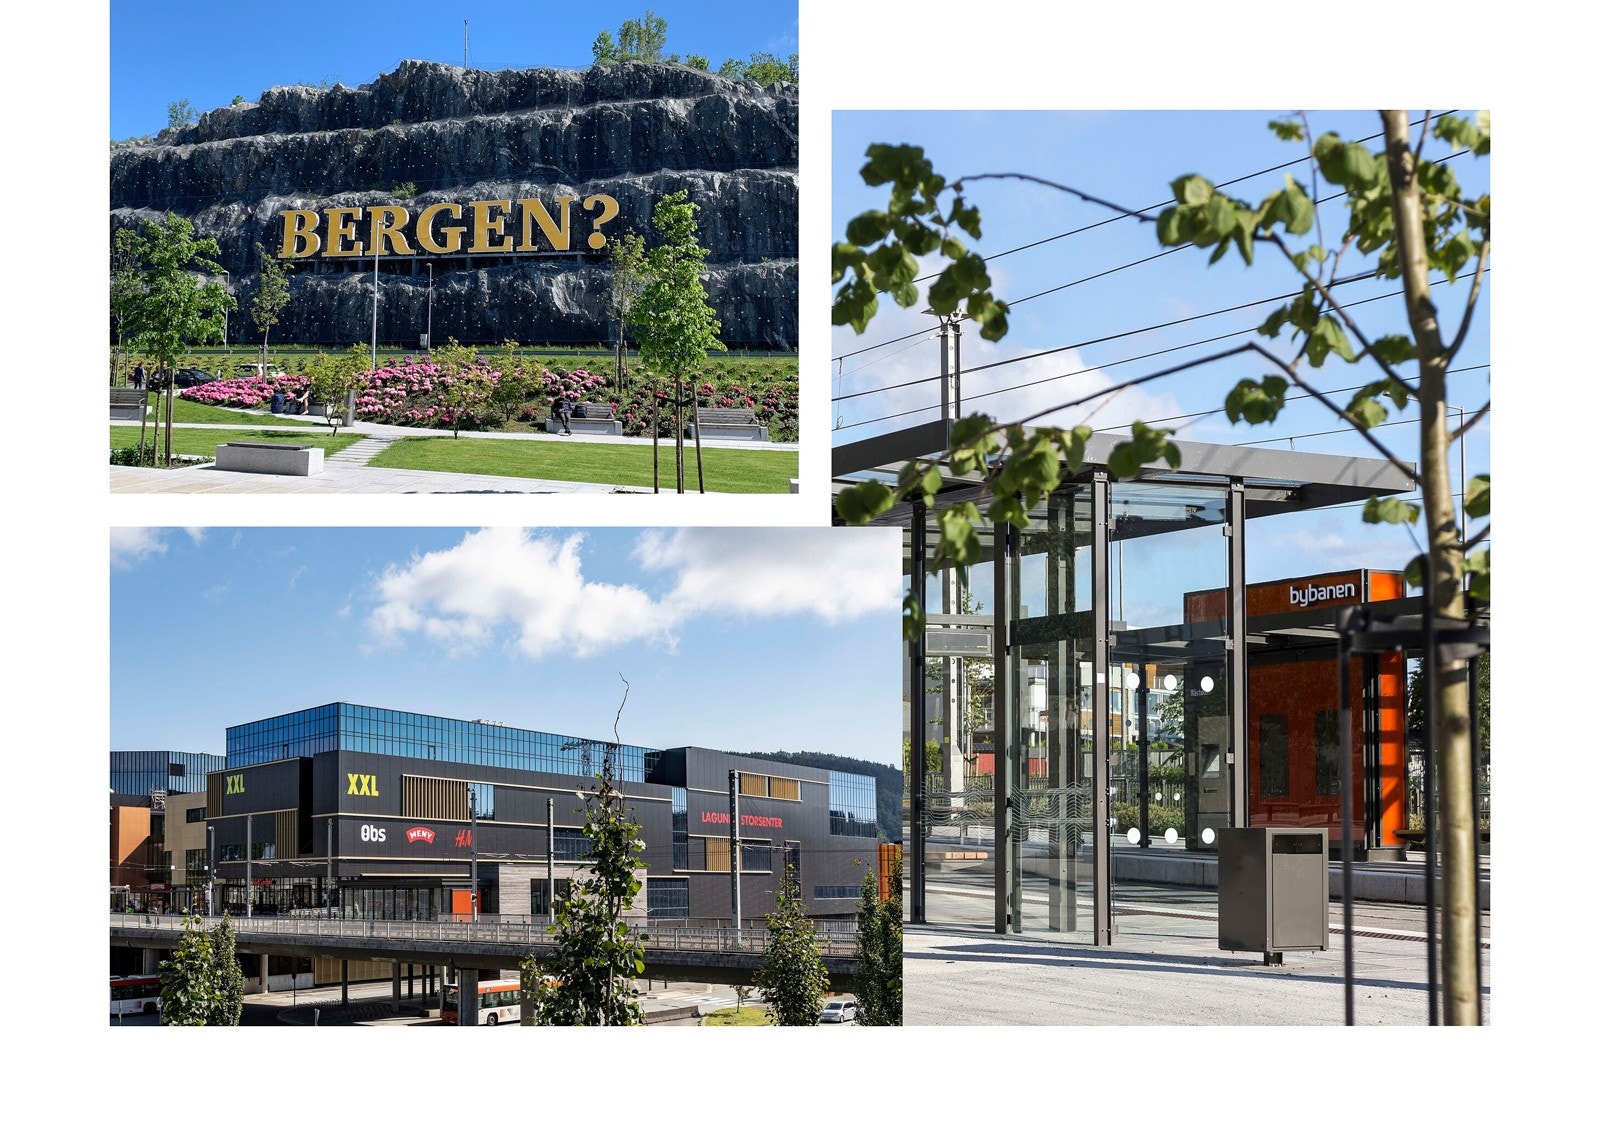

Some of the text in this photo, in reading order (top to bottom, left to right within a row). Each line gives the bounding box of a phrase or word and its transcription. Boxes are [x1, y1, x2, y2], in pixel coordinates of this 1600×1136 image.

[277, 194, 620, 259] BERGEN?
[1290, 583, 1355, 607] bybanen
[226, 773, 246, 795] XXL
[347, 773, 380, 797] XXL
[702, 811, 783, 828] LAGUN STORSENTER
[360, 824, 387, 842] Obs
[409, 829, 433, 840] MENY
